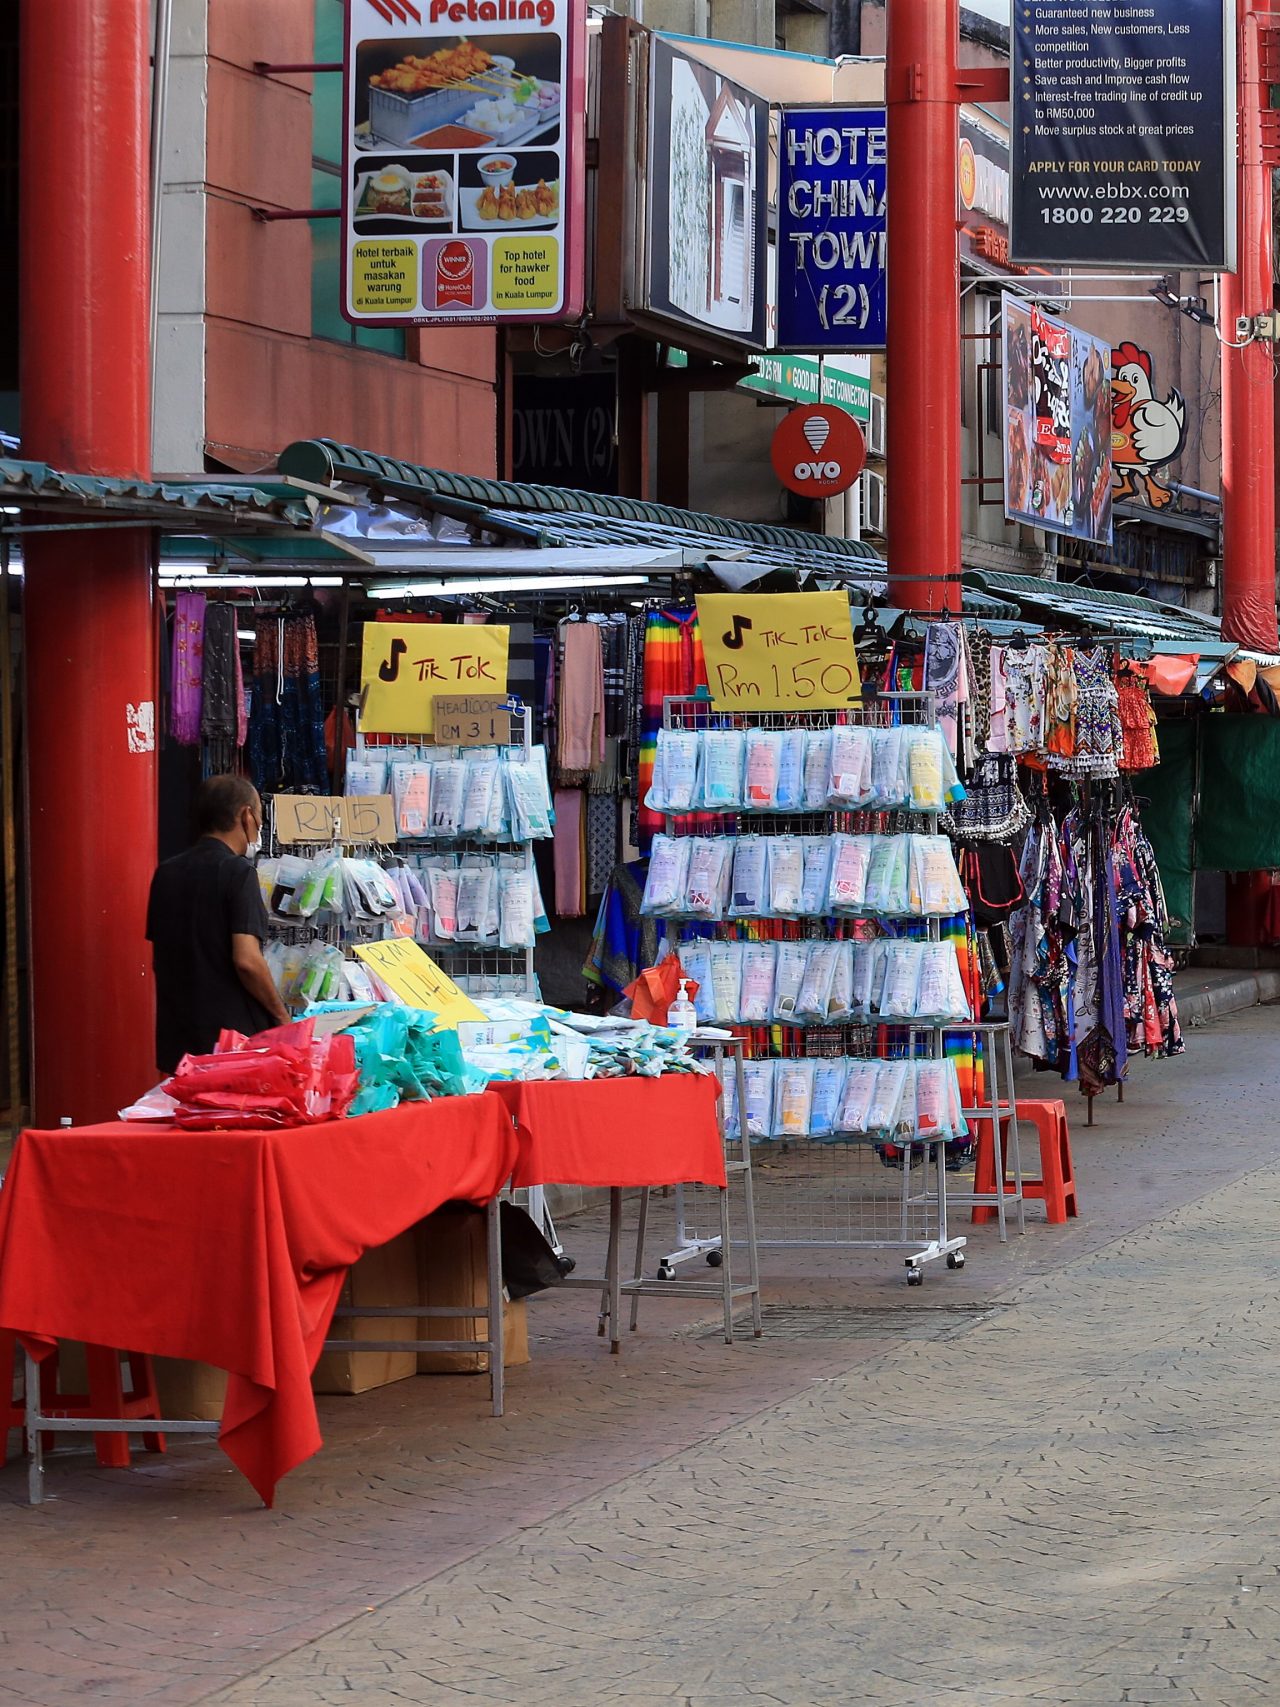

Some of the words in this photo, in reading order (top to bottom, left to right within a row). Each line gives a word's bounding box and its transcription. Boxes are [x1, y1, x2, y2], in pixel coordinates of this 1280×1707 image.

[430, 0, 555, 26] Petaling
[1035, 8, 1088, 18] Guaranteed
[1092, 10, 1110, 18] new
[1114, 7, 1154, 18] business
[1035, 25, 1059, 35] More
[1062, 25, 1088, 36] sales,
[1091, 24, 1111, 34] New
[1115, 24, 1166, 35] customers,
[1168, 24, 1190, 33] Less
[1035, 41, 1088, 53] competition
[1035, 58, 1063, 68] Better
[1066, 57, 1121, 70] productivity,
[1124, 57, 1153, 70] Bigger
[1157, 57, 1186, 69] profits
[1035, 75, 1057, 84] Save
[1060, 75, 1082, 84] cash
[1085, 75, 1101, 84] and
[1105, 75, 1142, 86] Improve
[1145, 74, 1166, 83] cash
[1169, 74, 1190, 83] flow
[1035, 91, 1092, 101] Interest-free
[1095, 91, 1126, 103] trading
[1130, 91, 1147, 101] line
[1150, 91, 1158, 100] of
[1161, 91, 1187, 100] credit
[1190, 92, 1202, 102] up
[1035, 109, 1043, 118] to
[1047, 108, 1094, 119] RM50,000
[1035, 125, 1060, 135] Move
[1063, 125, 1096, 137] surplus
[1099, 125, 1124, 135] stock
[1127, 124, 1136, 134] at
[1139, 125, 1163, 136] great
[1166, 124, 1194, 136] prices
[1029, 162, 1065, 173] APPLY
[1069, 161, 1090, 172] FOR
[1094, 161, 1124, 172] YOUR
[1128, 161, 1158, 172] CARD
[1162, 161, 1201, 172] TODAY
[1039, 182, 1189, 198] www.ebbx.com
[1041, 207, 1093, 223] 1800
[1101, 207, 1141, 223] 220
[1149, 207, 1189, 223] 229
[356, 248, 379, 257] Hotel
[383, 246, 413, 256] terbaik
[504, 252, 520, 261] Top
[523, 250, 545, 260] hotel
[370, 260, 396, 268] untuk
[500, 264, 513, 273] for
[516, 264, 550, 272] hawker
[364, 272, 405, 280] masakan
[515, 276, 535, 285] food
[367, 284, 401, 294] warung
[527, 291, 552, 299] Lumpur
[365, 297, 384, 305] Kuala
[386, 297, 412, 306] Lumpur
[819, 284, 869, 329] (2)
[773, 362, 781, 383] RM
[793, 368, 809, 390] GOOD
[811, 373, 836, 397] INTRNET
[837, 381, 868, 408] CONNECTION
[794, 462, 840, 479] OYO
[772, 658, 852, 698] 1.50
[468, 722, 480, 737] 3
[295, 802, 340, 833] RM
[352, 803, 380, 835] 5
[367, 943, 412, 969] RM
